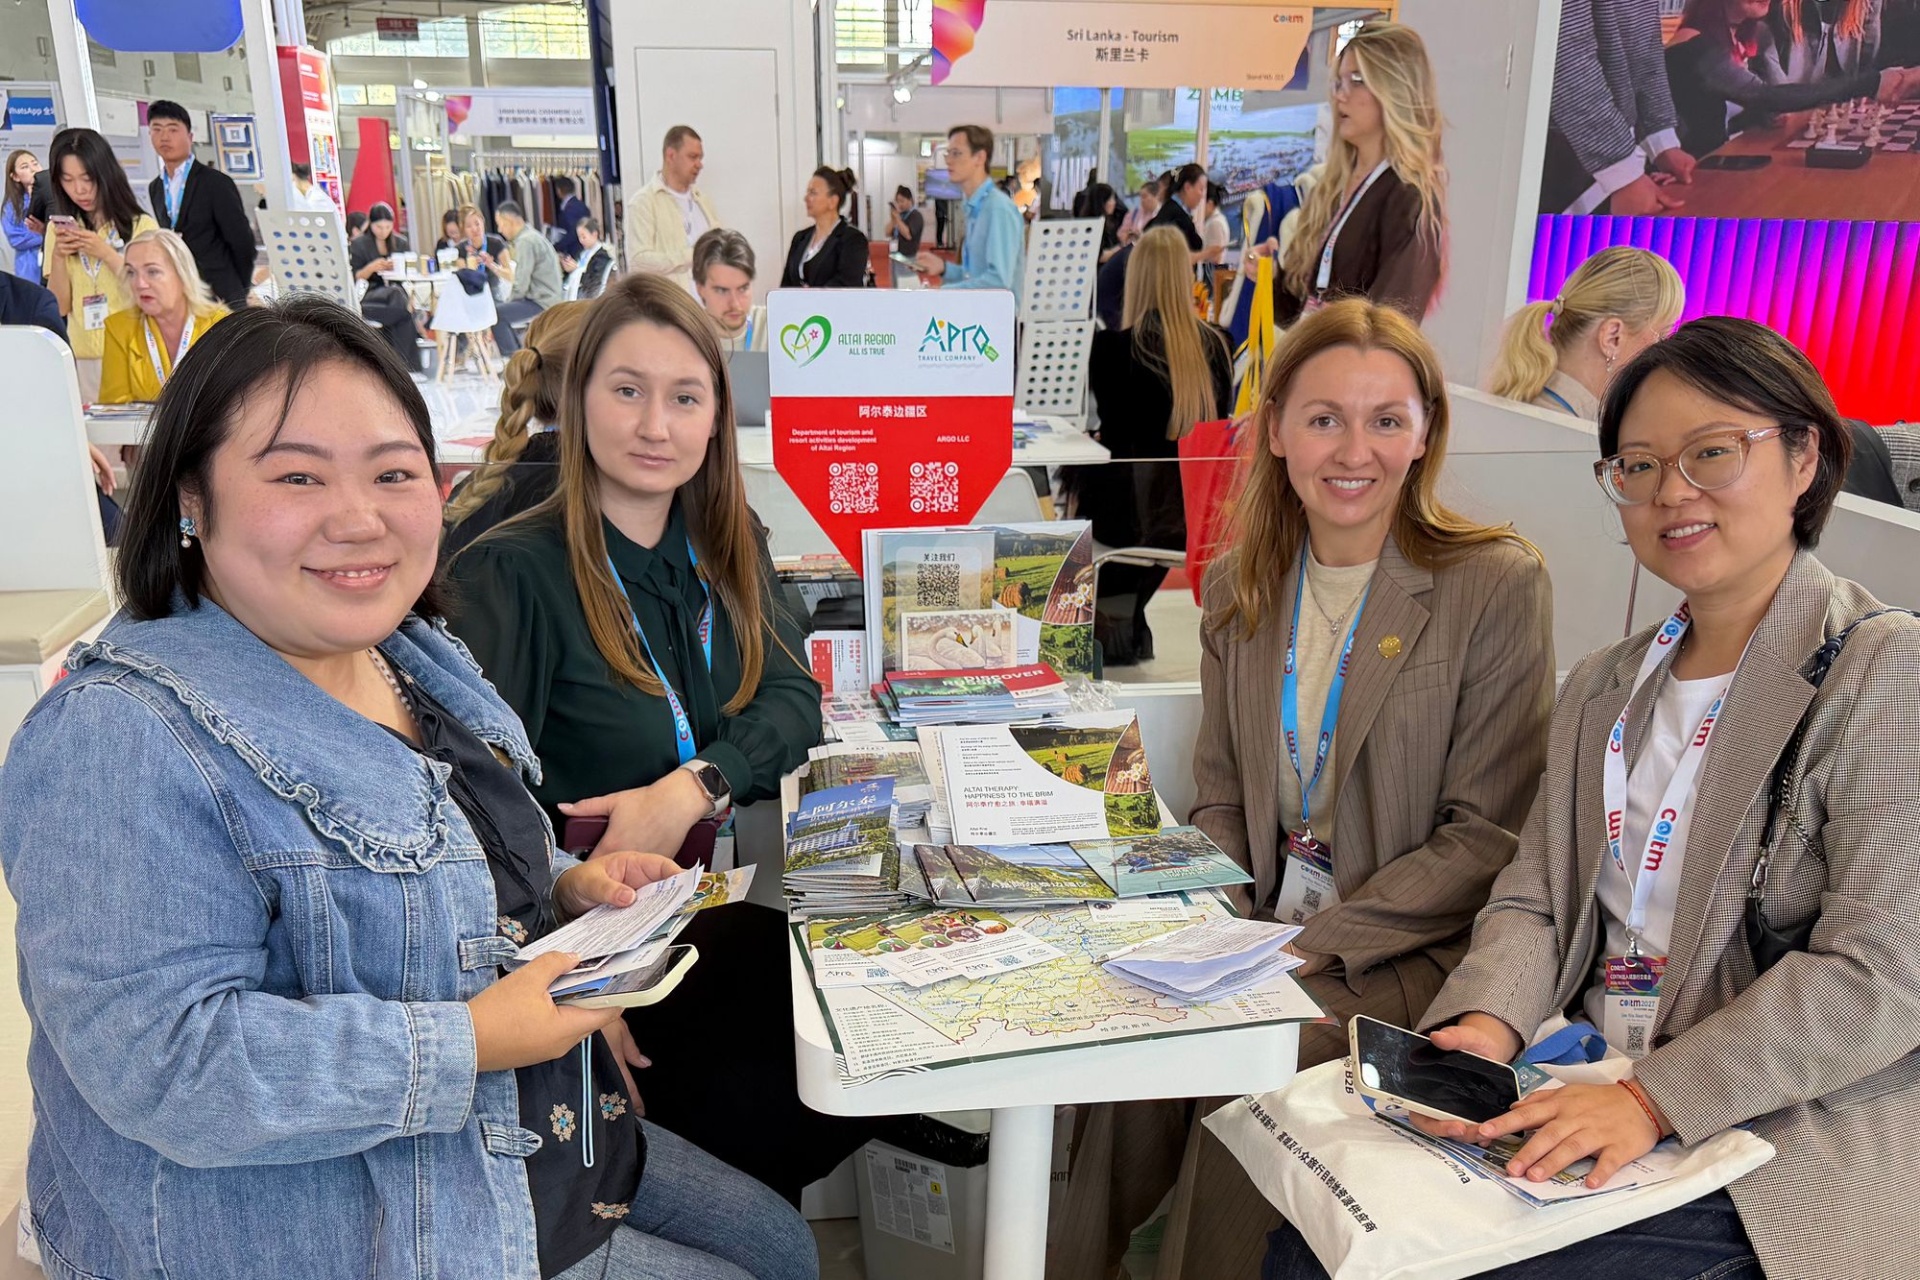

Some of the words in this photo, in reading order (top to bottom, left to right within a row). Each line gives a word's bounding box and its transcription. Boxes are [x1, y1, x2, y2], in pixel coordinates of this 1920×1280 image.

[1067, 29, 1084, 41] Sri
[1086, 30, 1122, 42] Lanka
[1133, 31, 1179, 43] Tourism
[1095, 47, 1150, 62] 斯里兰卡
[838, 333, 862, 345] ALTAI
[858, 405, 927, 418] 阿尔泰边疆区
[792, 428, 828, 437] Department
[837, 436, 877, 445] development
[834, 444, 856, 452] Region
[924, 553, 955, 561] 关注我们
[963, 669, 1045, 682] DISCOVER
[1644, 808, 1677, 872] coitm
[1344, 1071, 1354, 1094] B2B
[1444, 1159, 1471, 1184] China
